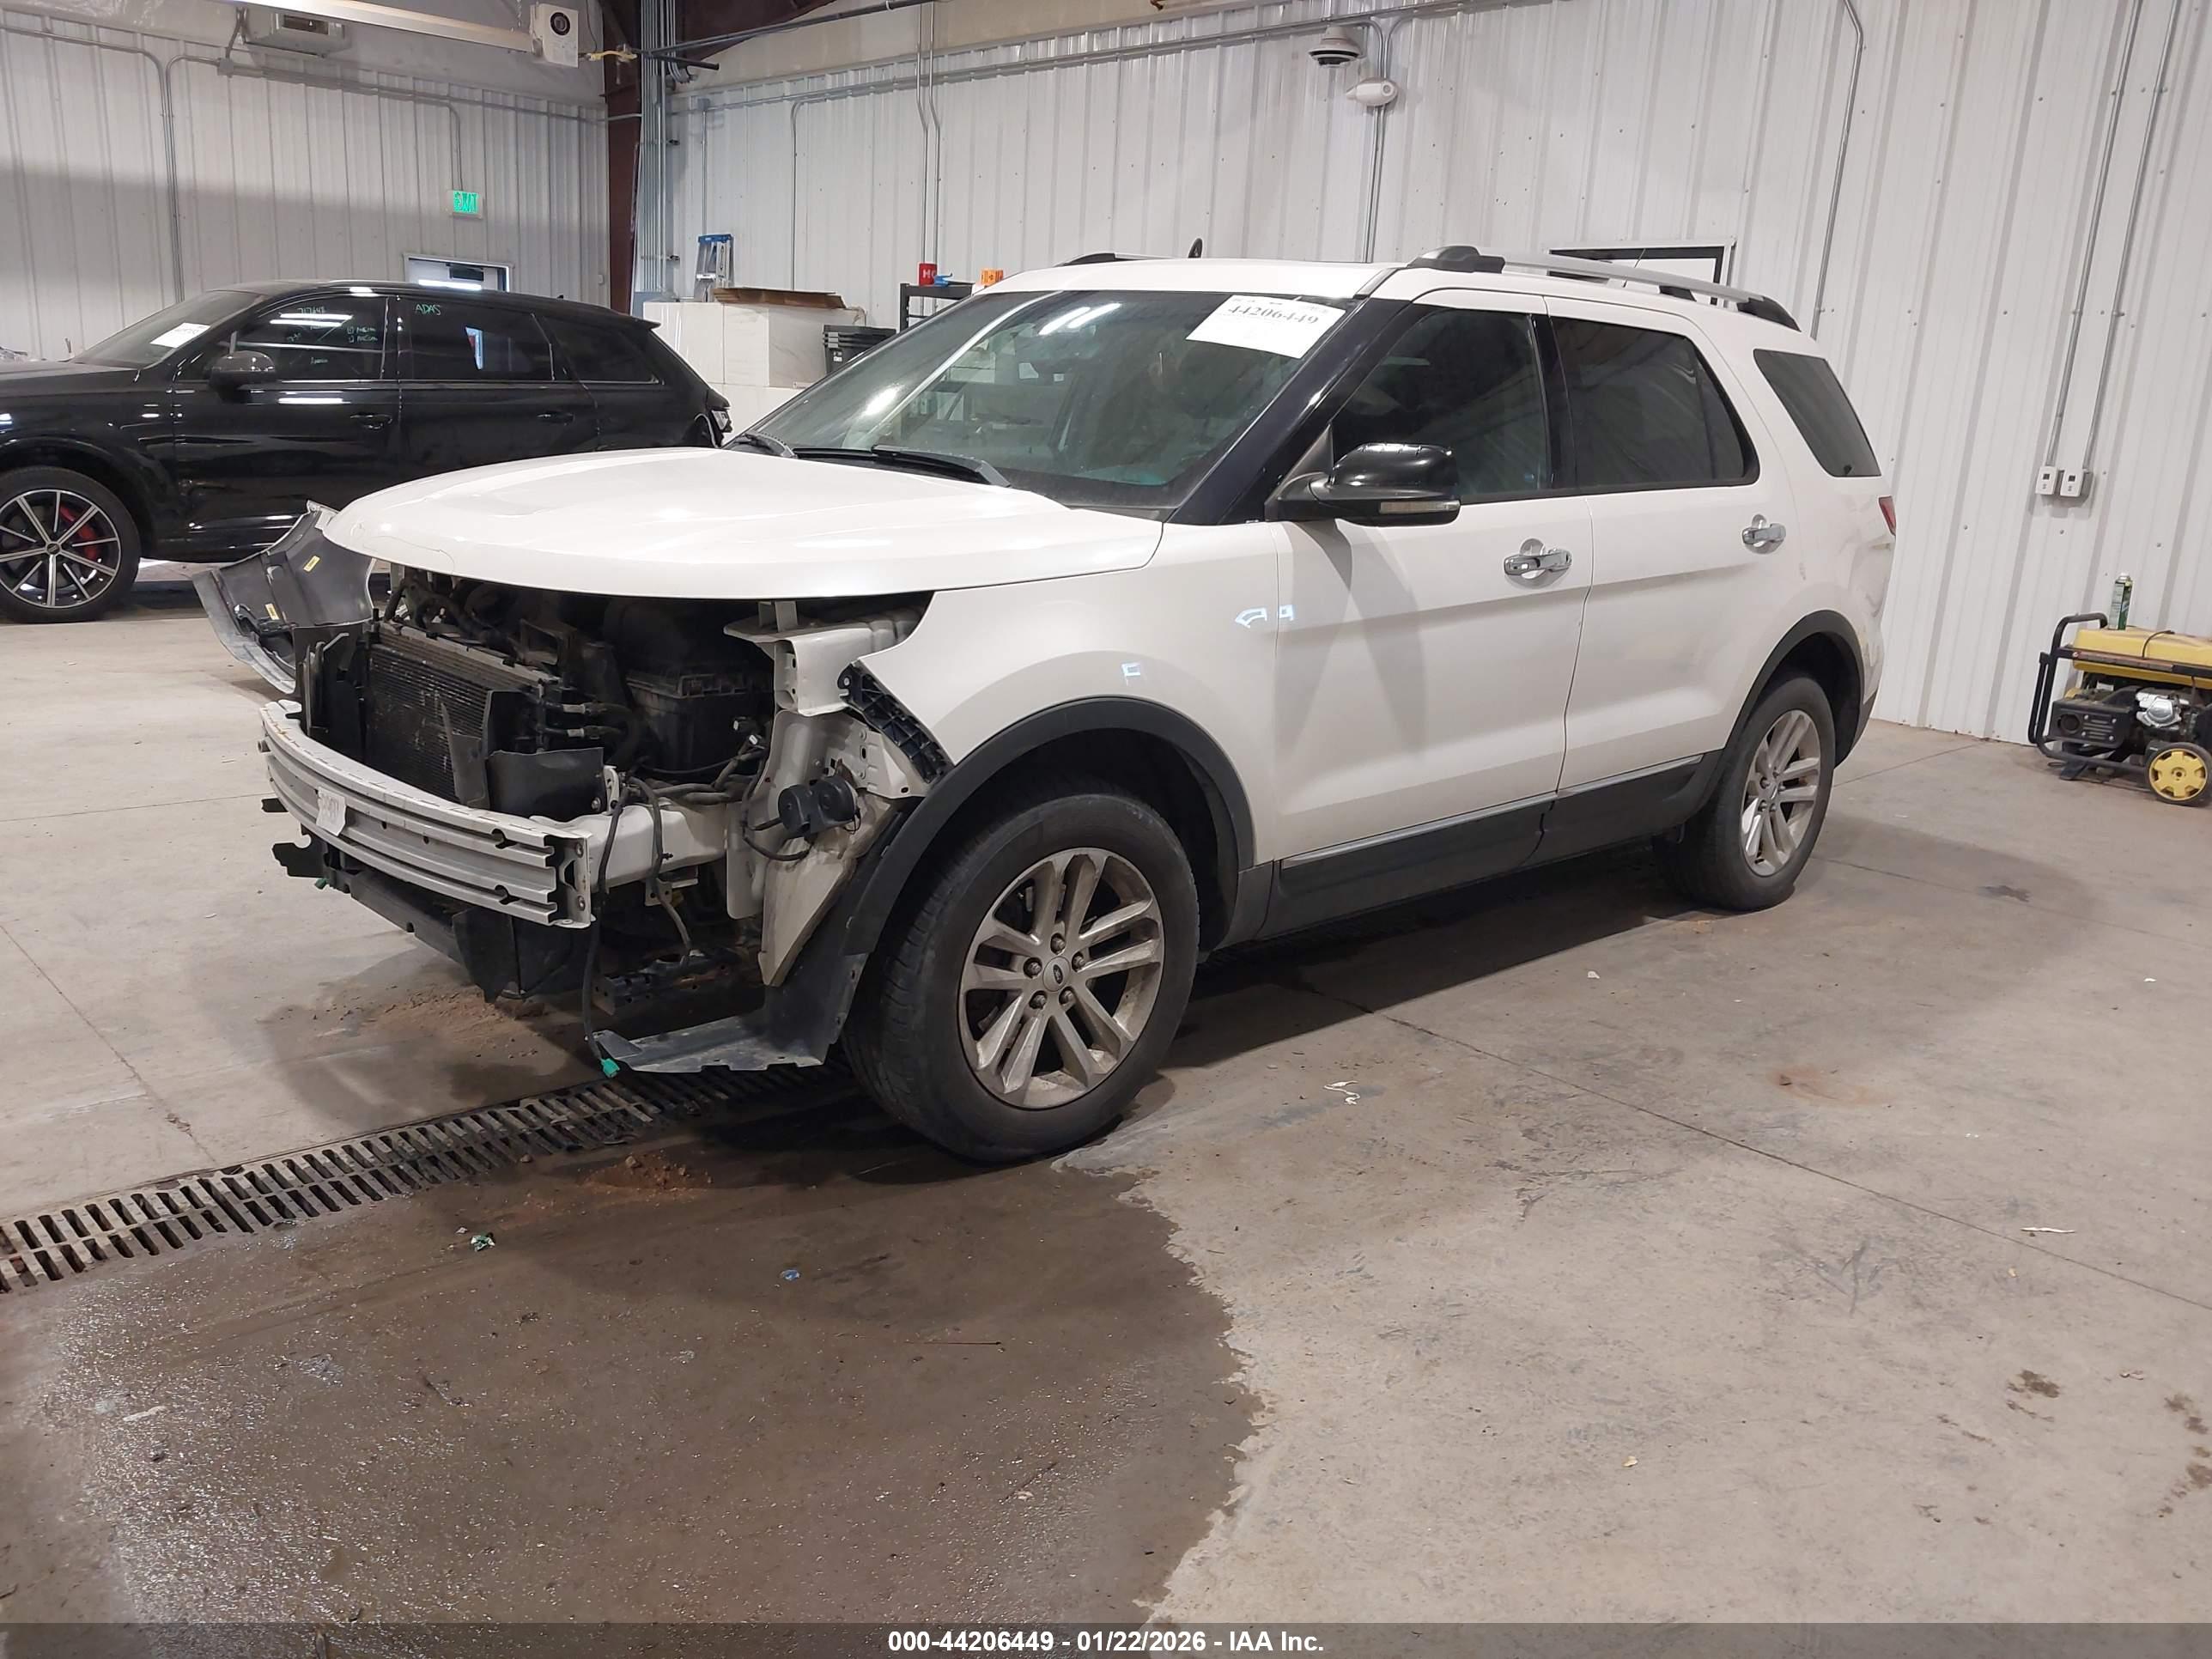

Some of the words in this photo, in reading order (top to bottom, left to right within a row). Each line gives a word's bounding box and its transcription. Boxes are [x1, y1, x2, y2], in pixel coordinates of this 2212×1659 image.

[453, 191, 478, 213] EXIT
[416, 303, 441, 316] ADAS
[1228, 304, 1319, 325] 44206449
